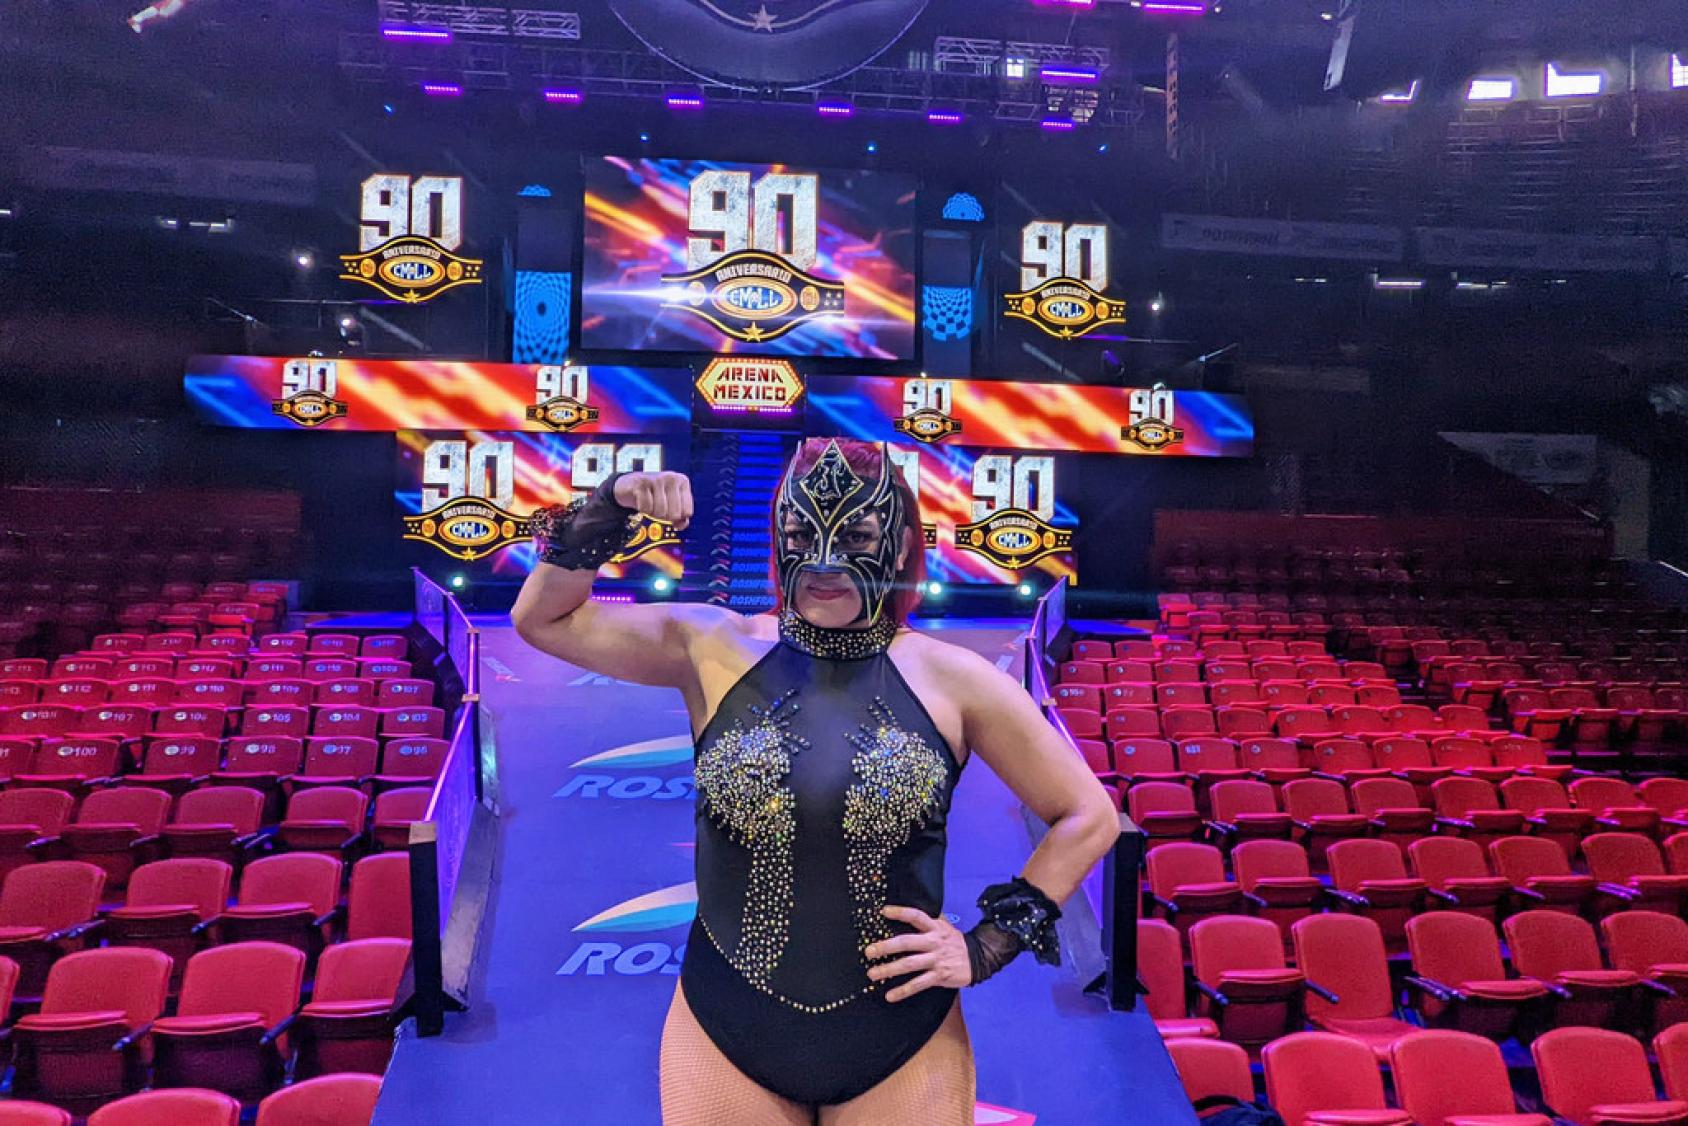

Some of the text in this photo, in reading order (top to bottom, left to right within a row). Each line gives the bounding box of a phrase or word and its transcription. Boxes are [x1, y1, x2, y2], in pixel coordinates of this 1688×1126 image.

[360, 174, 462, 252] 90
[687, 170, 819, 271] 90
[715, 264, 792, 283] ANIVERSARIO
[1021, 220, 1108, 293] 90
[282, 360, 337, 399] 90
[536, 366, 589, 404] 90
[714, 384, 787, 401] MEXICO
[716, 367, 784, 383] ARENA
[903, 380, 952, 417] 90
[1129, 389, 1174, 426] 90
[422, 441, 514, 513] 90
[972, 455, 1055, 523] 90
